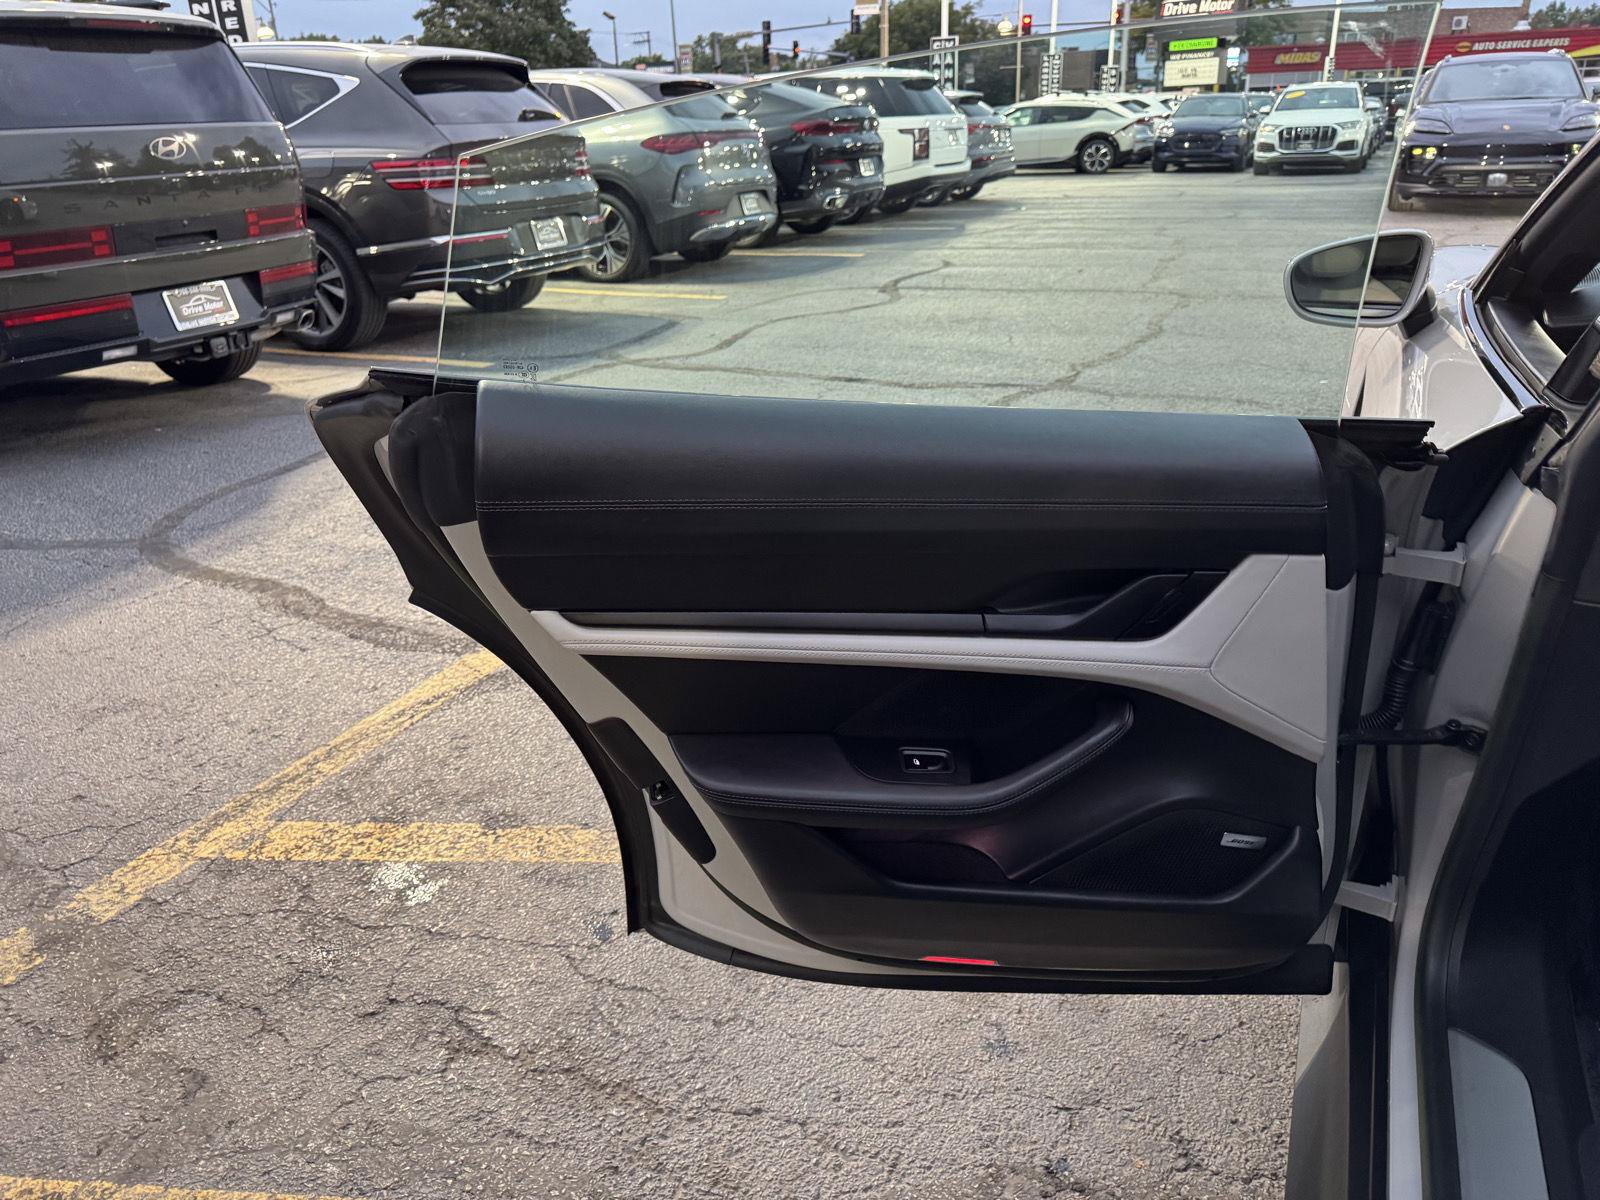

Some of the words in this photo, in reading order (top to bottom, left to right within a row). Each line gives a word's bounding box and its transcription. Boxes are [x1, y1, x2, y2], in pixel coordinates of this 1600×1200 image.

[1163, 2, 1198, 16] Drive
[1199, 0, 1235, 13] Motor
[1472, 41, 1495, 51] AUTO
[1496, 39, 1531, 50] SERVICE
[1531, 37, 1570, 47] EXPERTS
[1278, 52, 1319, 64] MIDAS
[64, 190, 210, 214] SANTA
[182, 304, 203, 316] Drive
[203, 301, 224, 310] Motor
